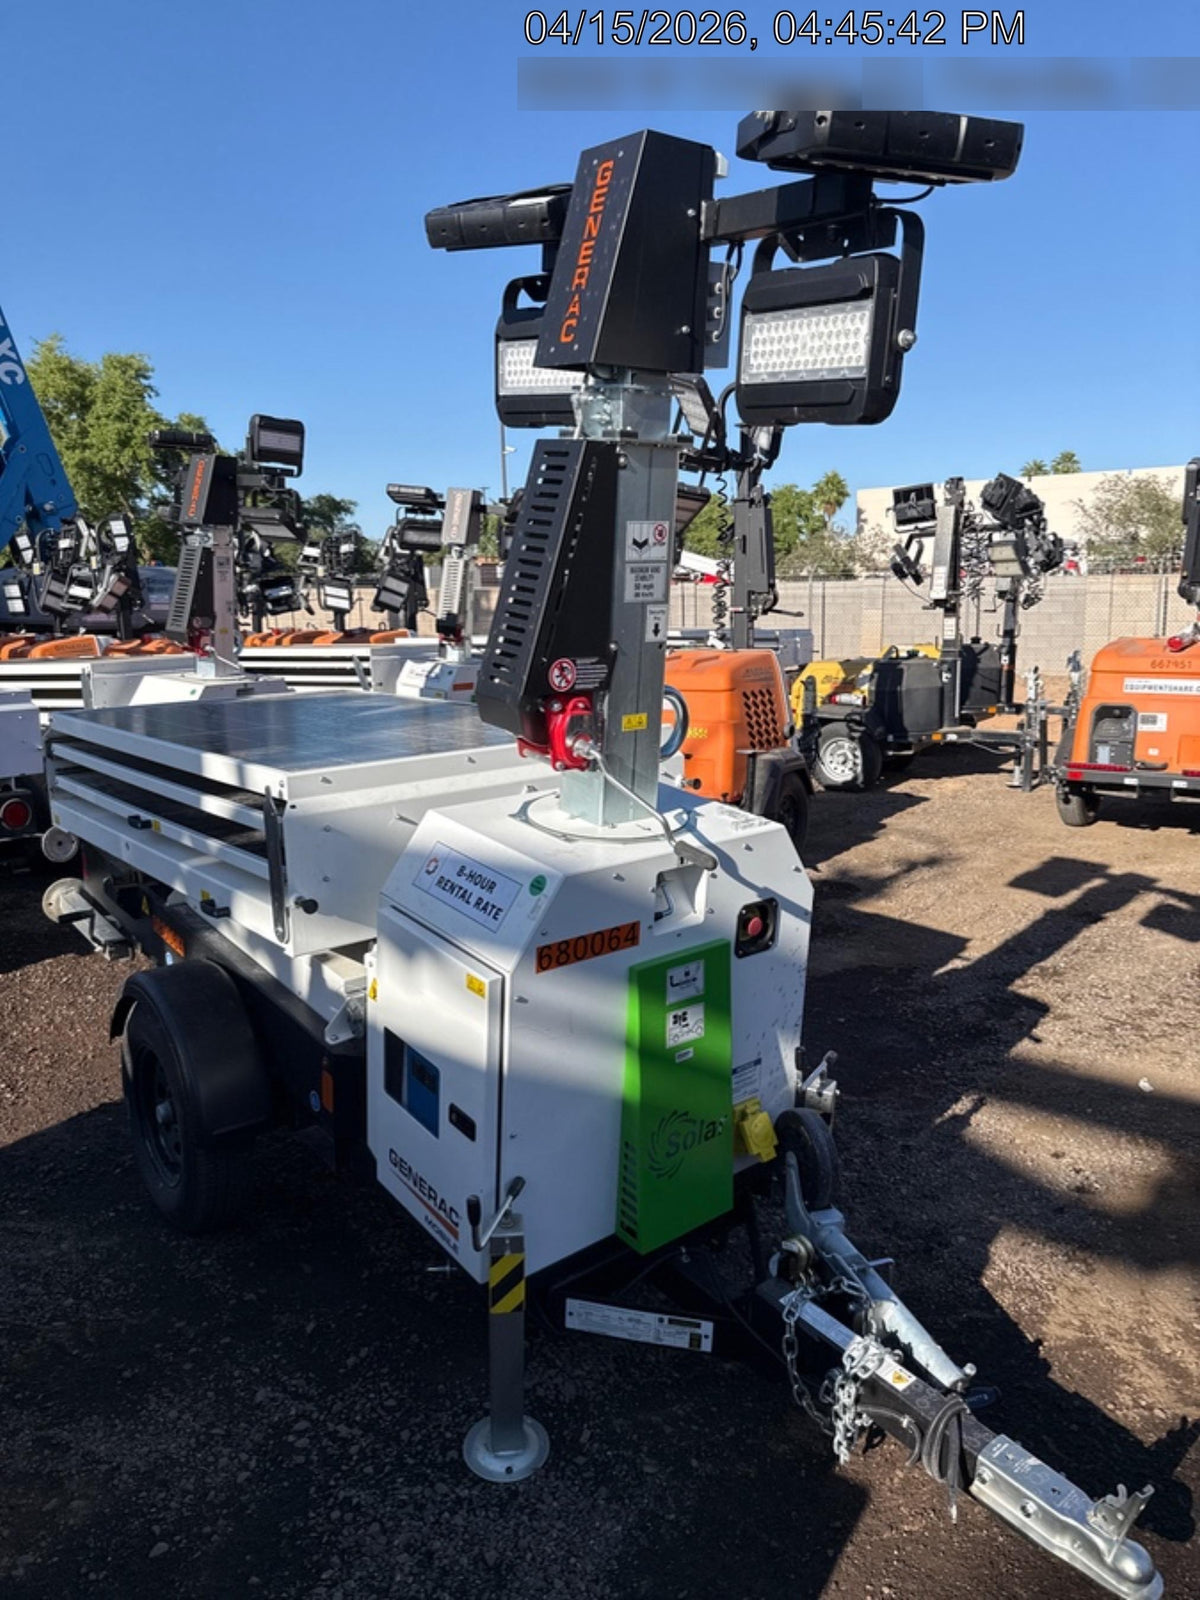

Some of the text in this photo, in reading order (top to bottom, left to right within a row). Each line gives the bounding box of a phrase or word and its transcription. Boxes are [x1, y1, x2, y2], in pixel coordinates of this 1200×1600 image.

[559, 158, 615, 344] GENERAC
[434, 875, 504, 921] RENTAL RATE
[455, 865, 498, 895] 8-HOUR
[538, 922, 638, 972] 680064
[388, 1147, 460, 1229] GENERAC
